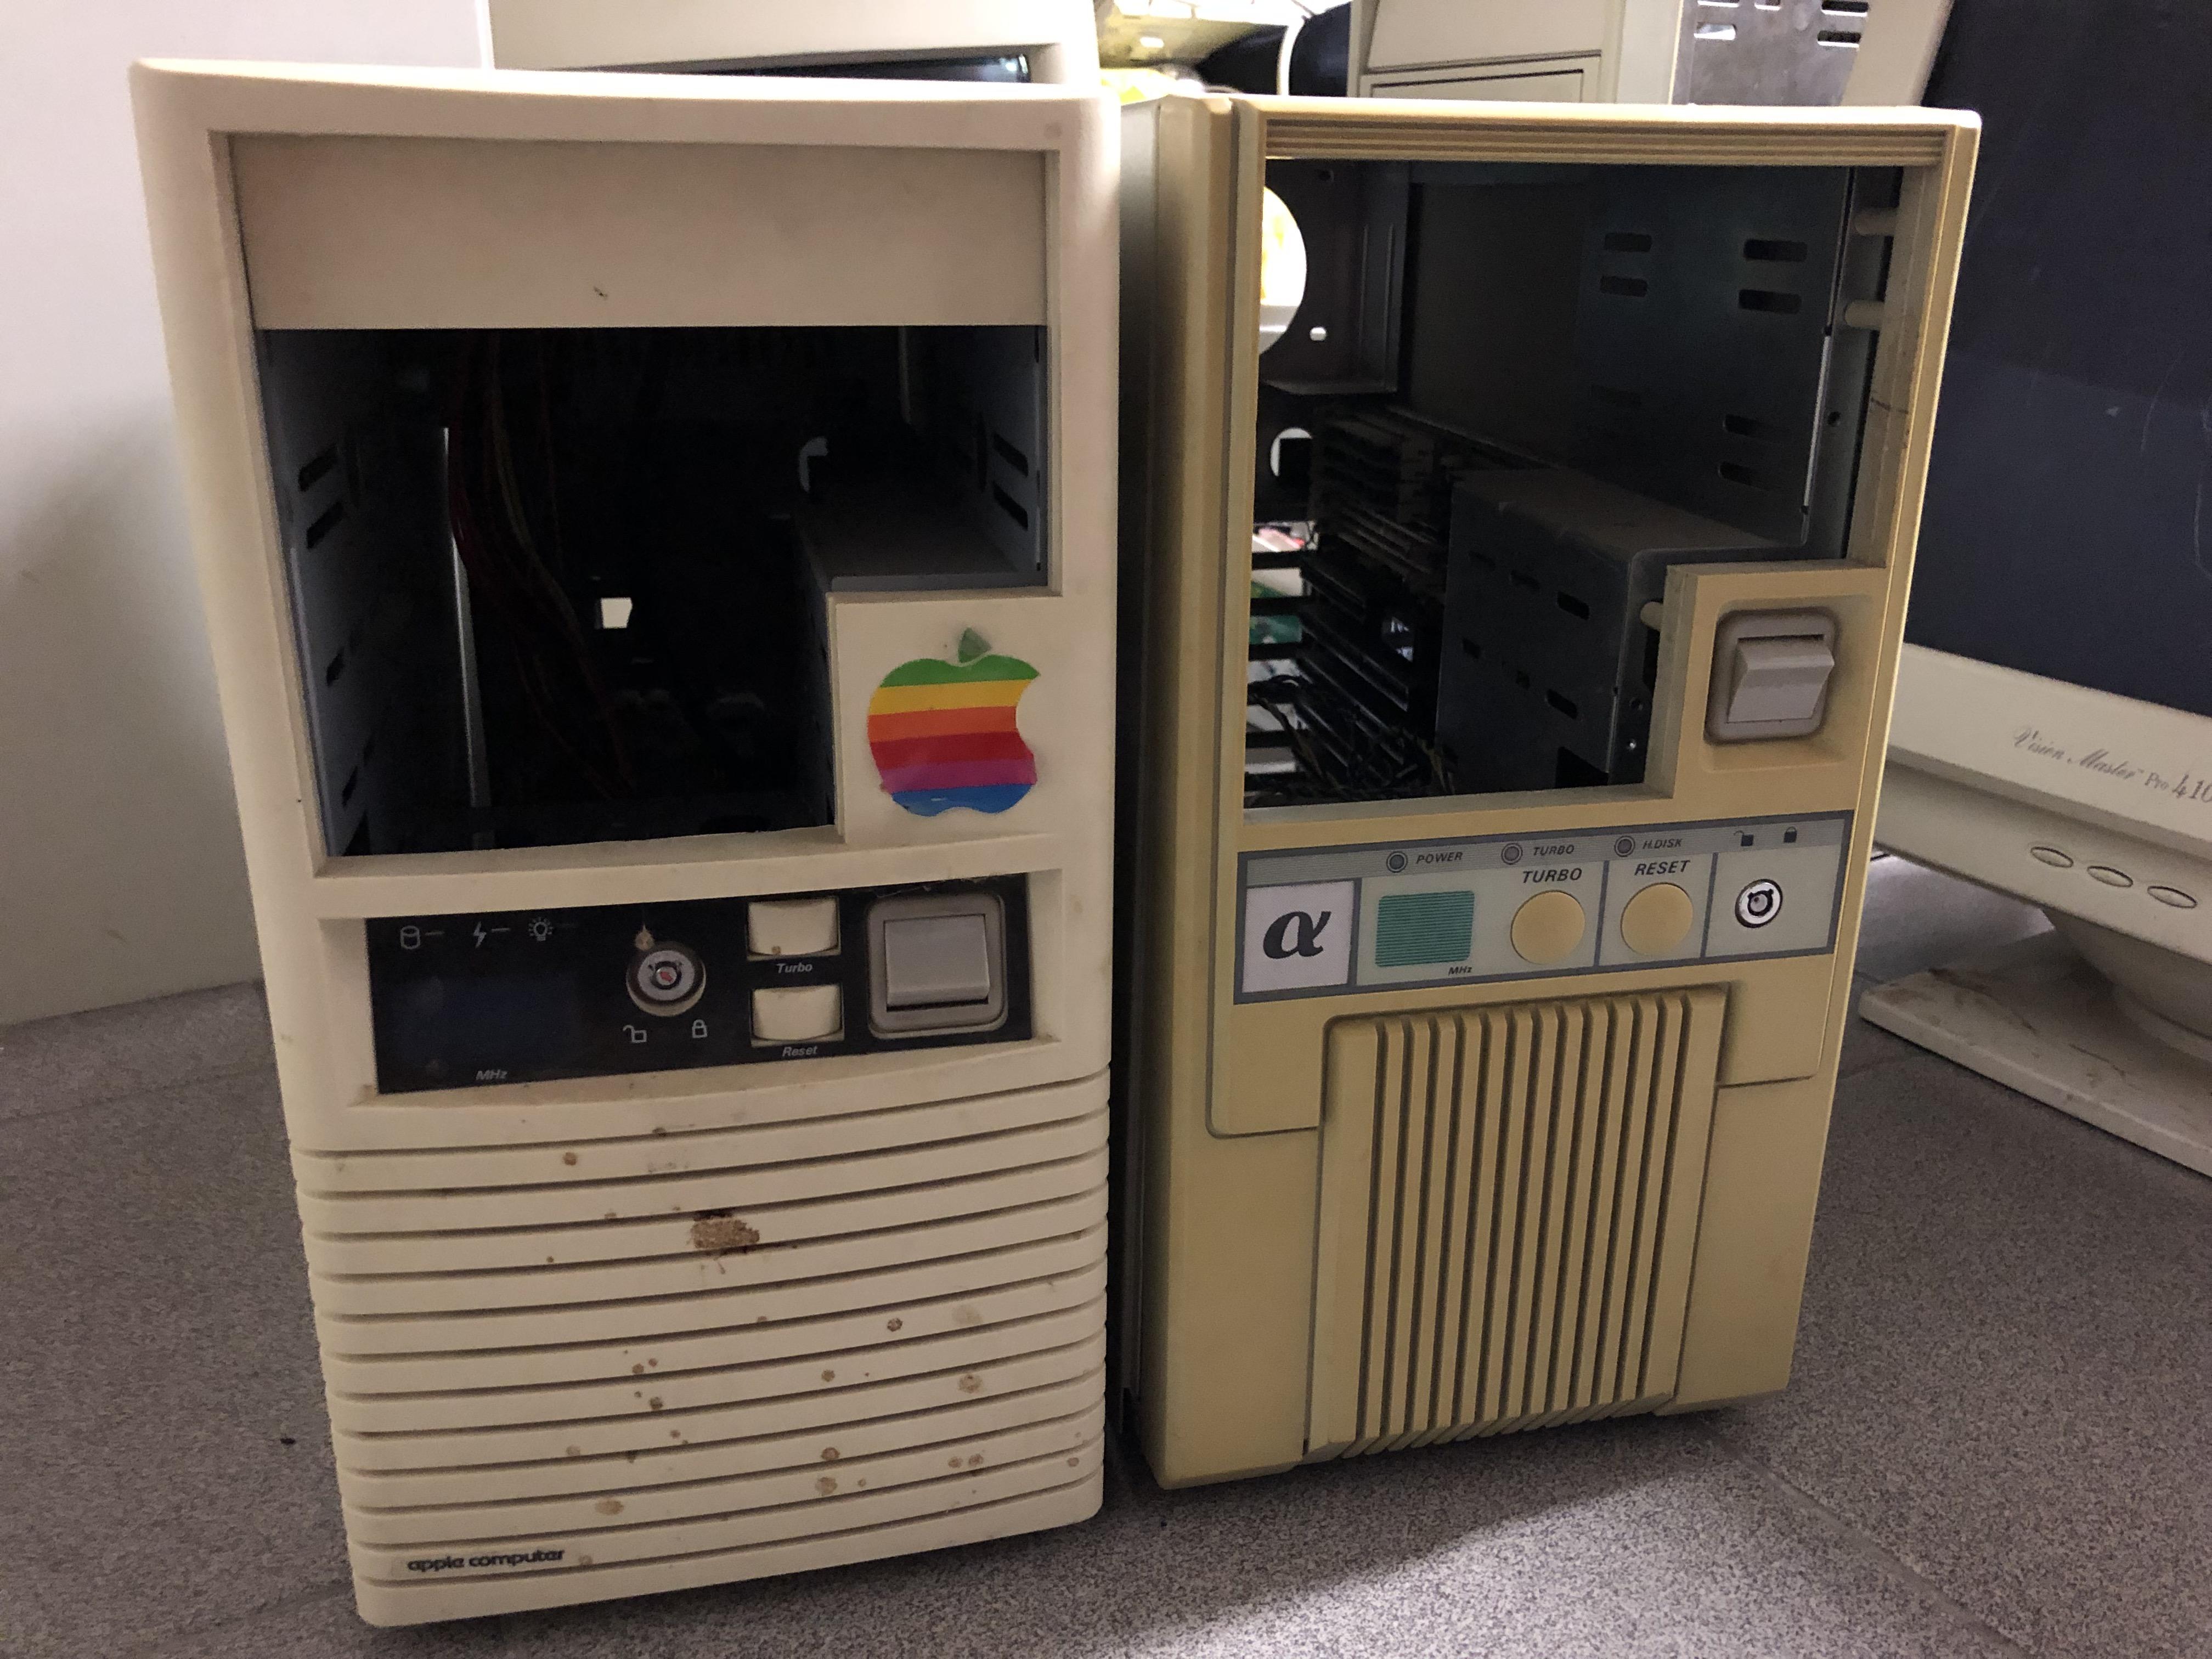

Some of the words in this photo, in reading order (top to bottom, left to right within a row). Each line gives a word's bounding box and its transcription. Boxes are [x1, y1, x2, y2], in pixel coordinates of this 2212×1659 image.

[1533, 844, 1575, 856] TURBO
[1416, 851, 1463, 865] POWER
[1634, 860, 1690, 876] RESET
[1522, 867, 1583, 884] TURBO
[776, 962, 814, 974] Turbo
[1448, 966, 1472, 975] MHz
[782, 1045, 817, 1058] Reset
[475, 1069, 508, 1080] MHz
[407, 1555, 465, 1572] apple
[469, 1548, 565, 1567] computer
